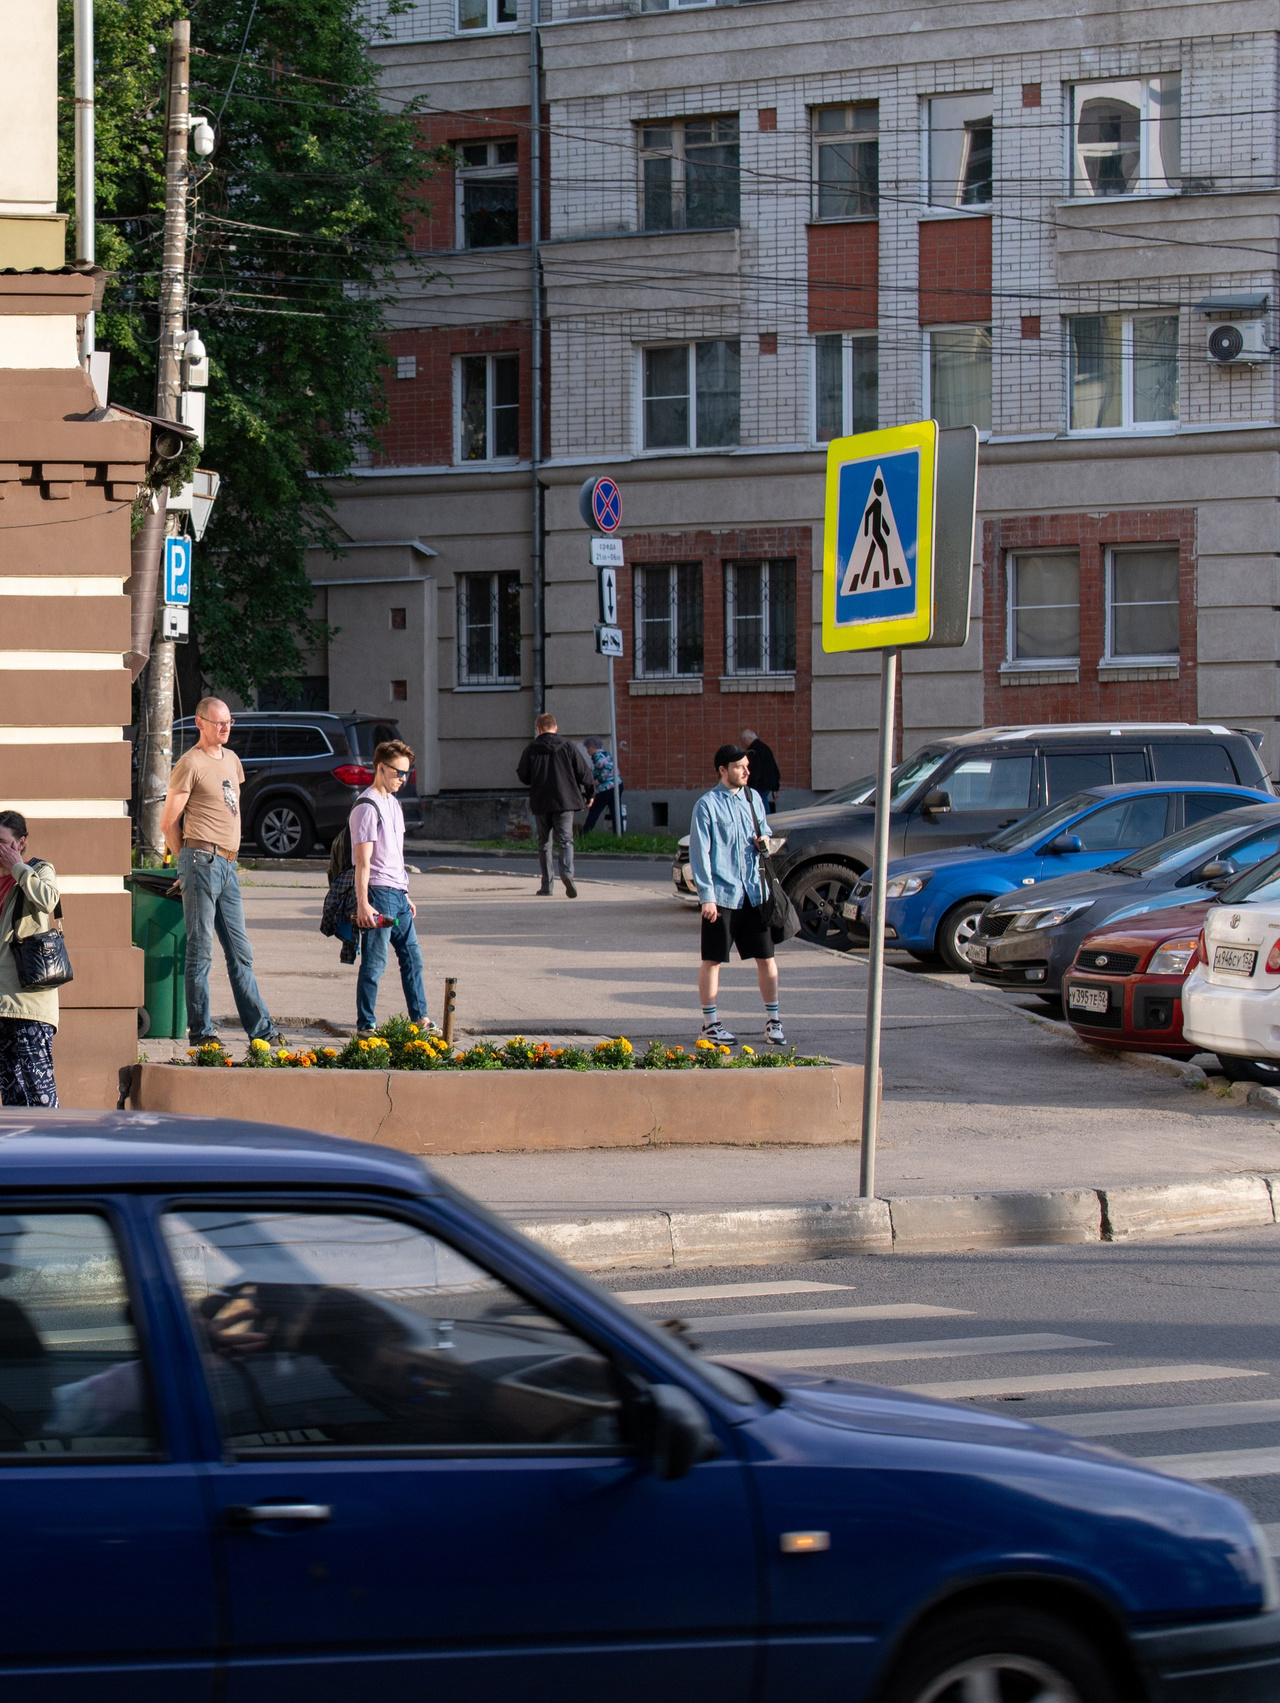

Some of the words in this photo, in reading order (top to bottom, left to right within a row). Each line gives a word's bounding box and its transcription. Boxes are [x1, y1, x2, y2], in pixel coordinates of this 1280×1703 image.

[171, 545, 186, 596] P
[1071, 989, 1097, 1005] У395ТЕ
[1099, 991, 1106, 1003] 52
